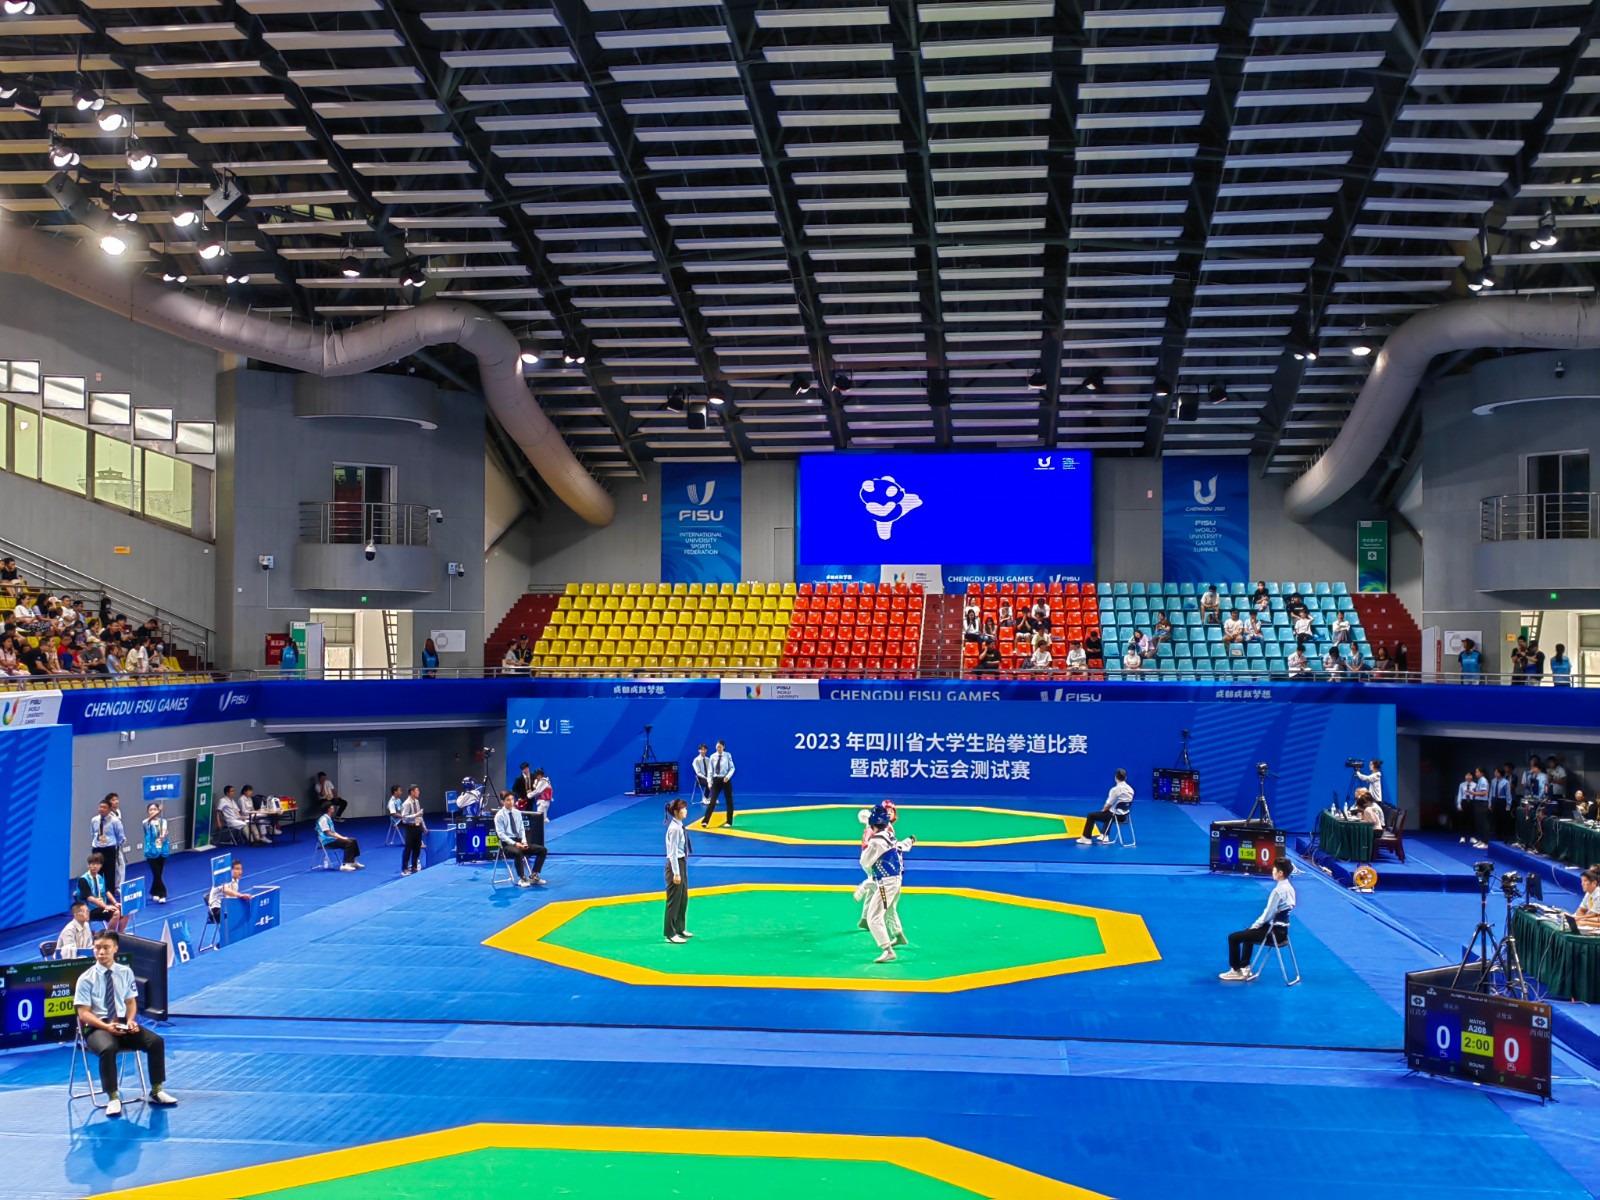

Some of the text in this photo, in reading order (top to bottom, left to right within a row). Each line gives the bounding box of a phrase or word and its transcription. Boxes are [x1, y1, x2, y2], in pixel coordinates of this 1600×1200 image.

[679, 510, 724, 521] FISU
[230, 694, 249, 705] FISU
[830, 690, 1000, 702] CHENGDU FISU GAMES
[1065, 693, 1102, 702] FISU
[84, 697, 189, 718] CHENGDU FISU GAMES
[794, 732, 1088, 754] 2023 年四川省大学生跆拳道比赛
[850, 758, 1030, 780] 暨成都大运会测试赛
[472, 835, 480, 848] 0
[1225, 845, 1233, 858] 0
[1261, 848, 1270, 862] 0
[177, 941, 190, 963] B
[51, 989, 70, 998] A208
[17, 999, 33, 1022] 0
[48, 1000, 73, 1013] 2:00
[1467, 1025, 1487, 1034] A208
[1436, 1025, 1451, 1049] 0
[1464, 1037, 1490, 1051] 2:00
[1504, 1037, 1520, 1063] 0
